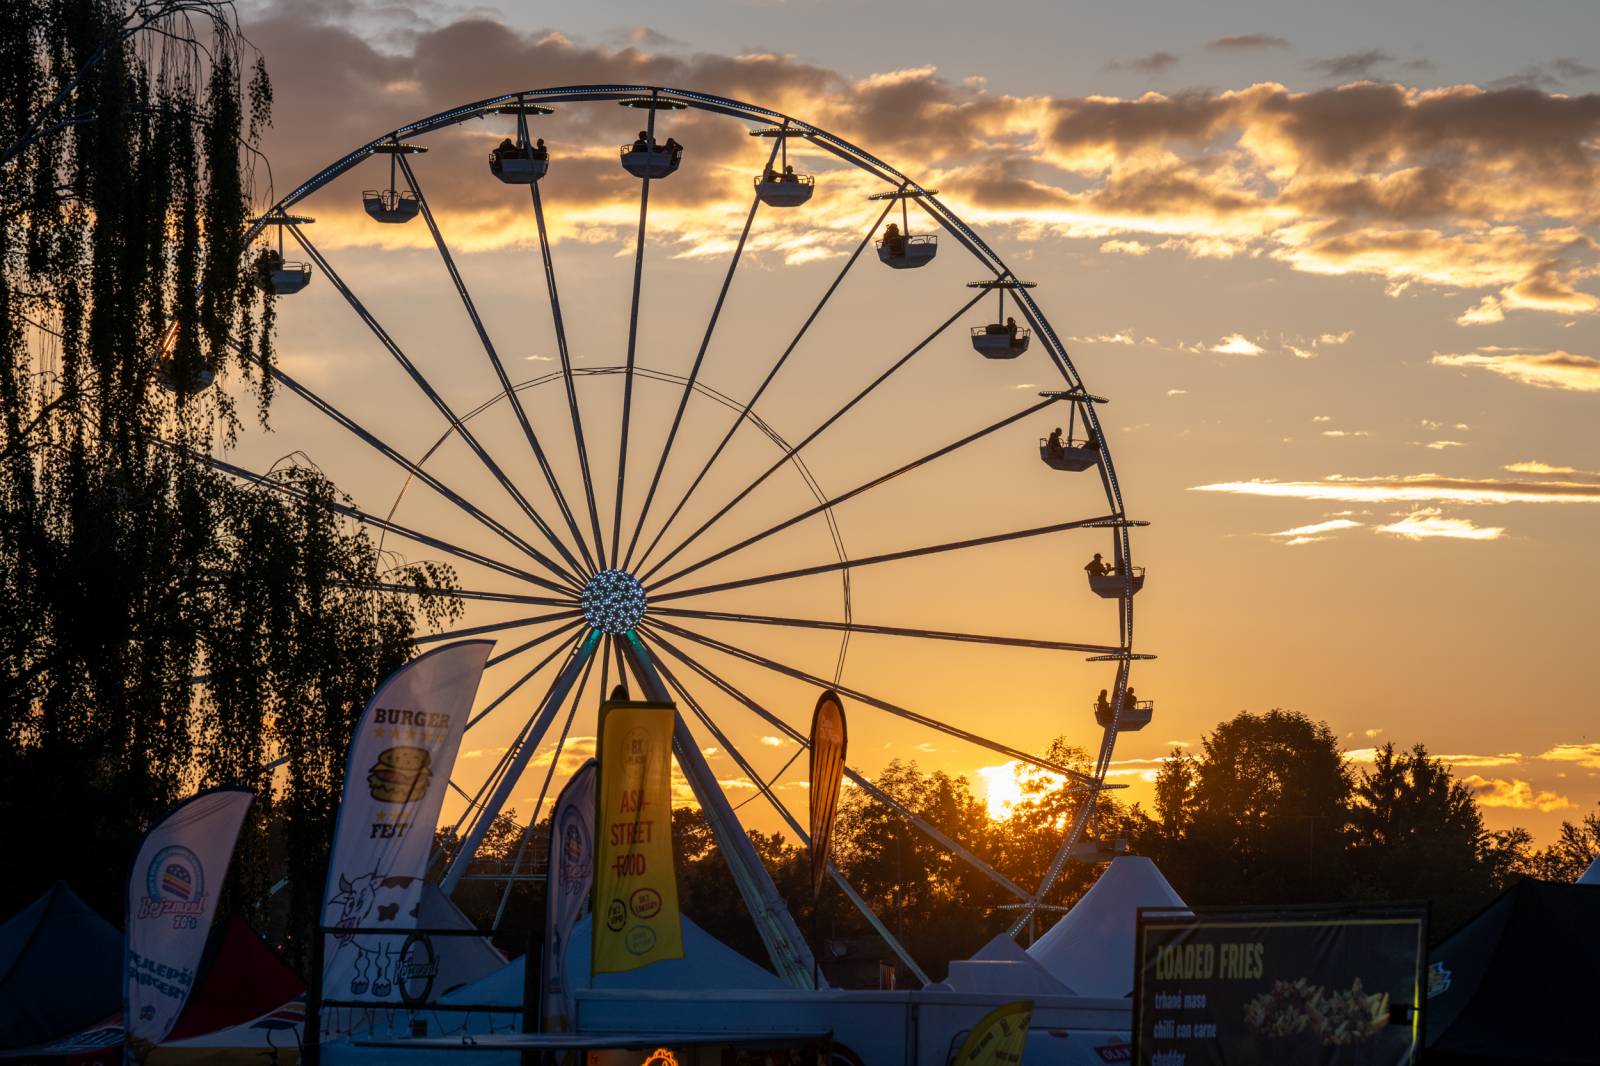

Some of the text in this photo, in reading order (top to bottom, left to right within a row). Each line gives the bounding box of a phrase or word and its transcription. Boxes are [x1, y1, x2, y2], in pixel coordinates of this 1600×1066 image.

[374, 708, 451, 729] BURGER
[370, 823, 410, 839] FEST
[610, 820, 654, 847] STREET
[612, 853, 646, 878] FOOD
[1154, 942, 1264, 980] LOADED FRIES
[1154, 990, 1207, 1009] trhané maso
[1176, 1022, 1193, 1039] con
[1193, 1022, 1217, 1039] carne
